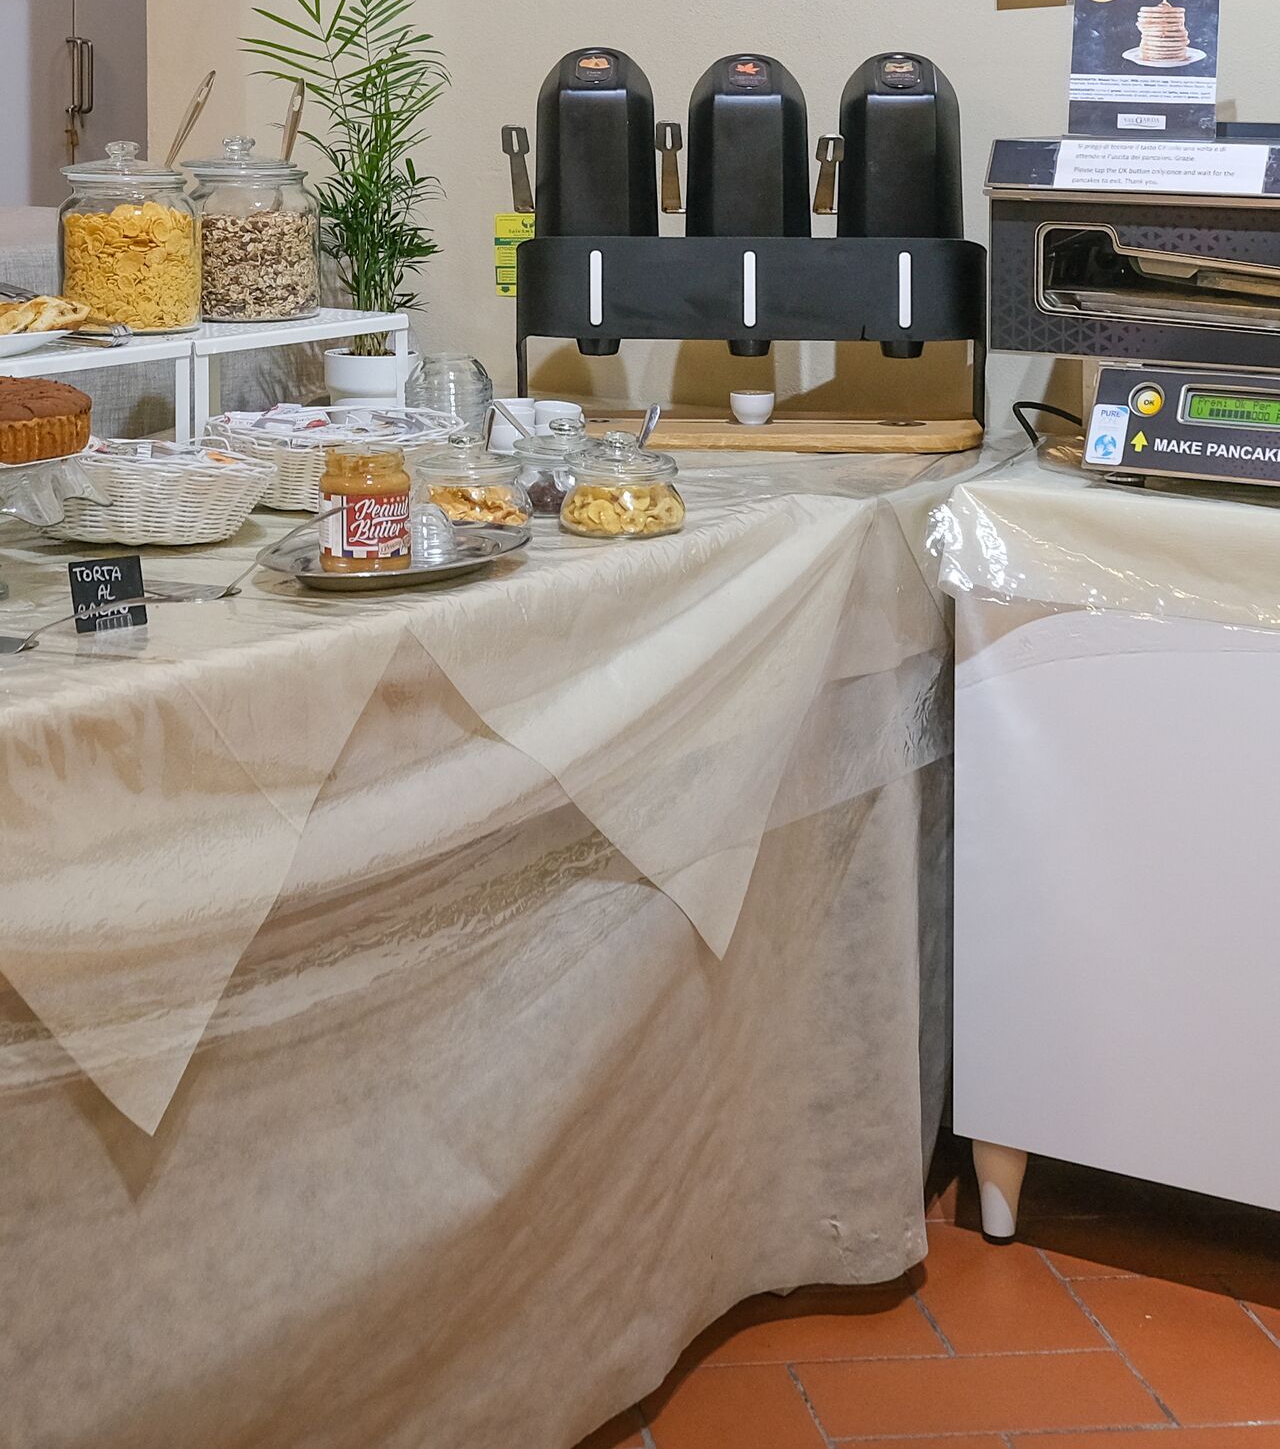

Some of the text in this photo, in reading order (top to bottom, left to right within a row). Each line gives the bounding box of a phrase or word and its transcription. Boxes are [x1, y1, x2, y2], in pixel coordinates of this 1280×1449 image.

[1143, 399, 1155, 407] OK
[1154, 438, 1203, 456] MAKE
[354, 496, 409, 521] Peanut
[349, 518, 403, 545] Butter
[72, 565, 122, 582] TORTA
[97, 584, 116, 600] AL
